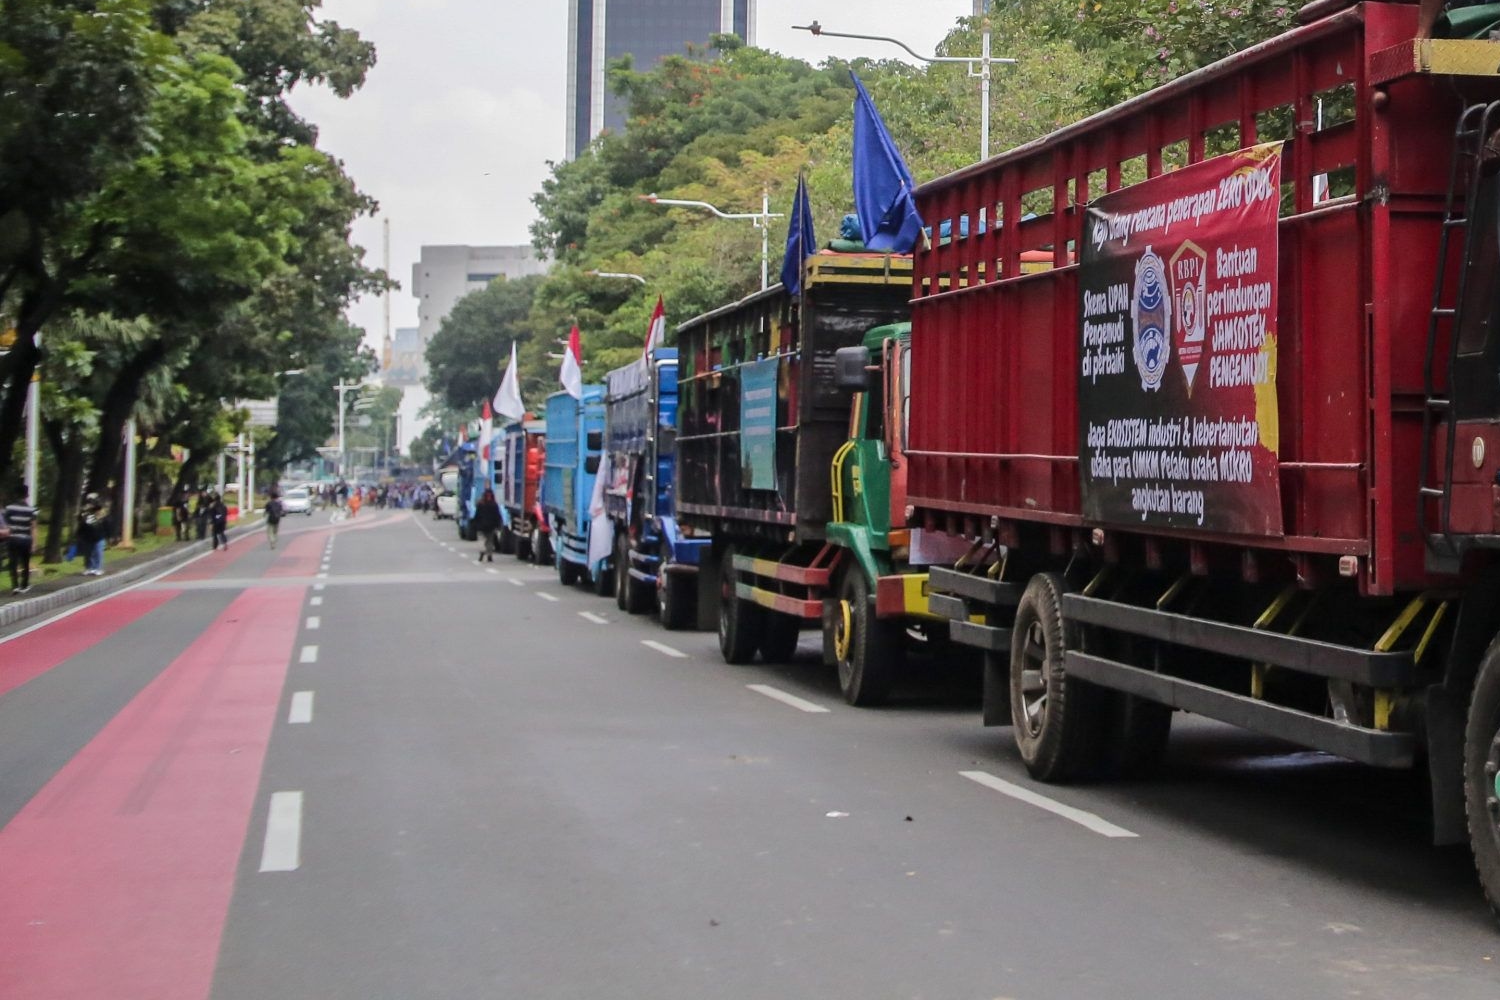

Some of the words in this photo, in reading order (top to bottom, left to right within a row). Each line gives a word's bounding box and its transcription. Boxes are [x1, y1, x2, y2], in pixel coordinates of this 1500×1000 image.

[1130, 203, 1166, 234] rencana
[1165, 188, 1217, 235] penerapan
[1217, 175, 1243, 211] ZERO
[1178, 257, 1199, 280] RBPI
[1216, 245, 1257, 279] Bantuan
[1084, 289, 1107, 318] Skema
[1108, 283, 1129, 311] UPAH
[1207, 279, 1271, 327] perlindungan
[1083, 313, 1124, 350] Pengemudi
[1212, 313, 1267, 352] JAMSOSTEK
[1092, 346, 1125, 384] perbaiki
[1210, 352, 1269, 388] PENGEMUDI
[1088, 421, 1105, 453] Jaga
[1107, 418, 1147, 447] EKOSISTEM
[1148, 416, 1181, 447] industri
[1182, 416, 1191, 447] &
[1193, 415, 1258, 450] keberlanjutan
[1091, 450, 1112, 478] usaha
[1113, 456, 1131, 486] para
[1132, 450, 1159, 479] UMKM
[1161, 450, 1189, 480] Pelaku
[1191, 450, 1218, 481] usaha
[1220, 450, 1252, 483] MIKRO
[1131, 483, 1170, 521] angkutan
[1170, 483, 1204, 526] barang
